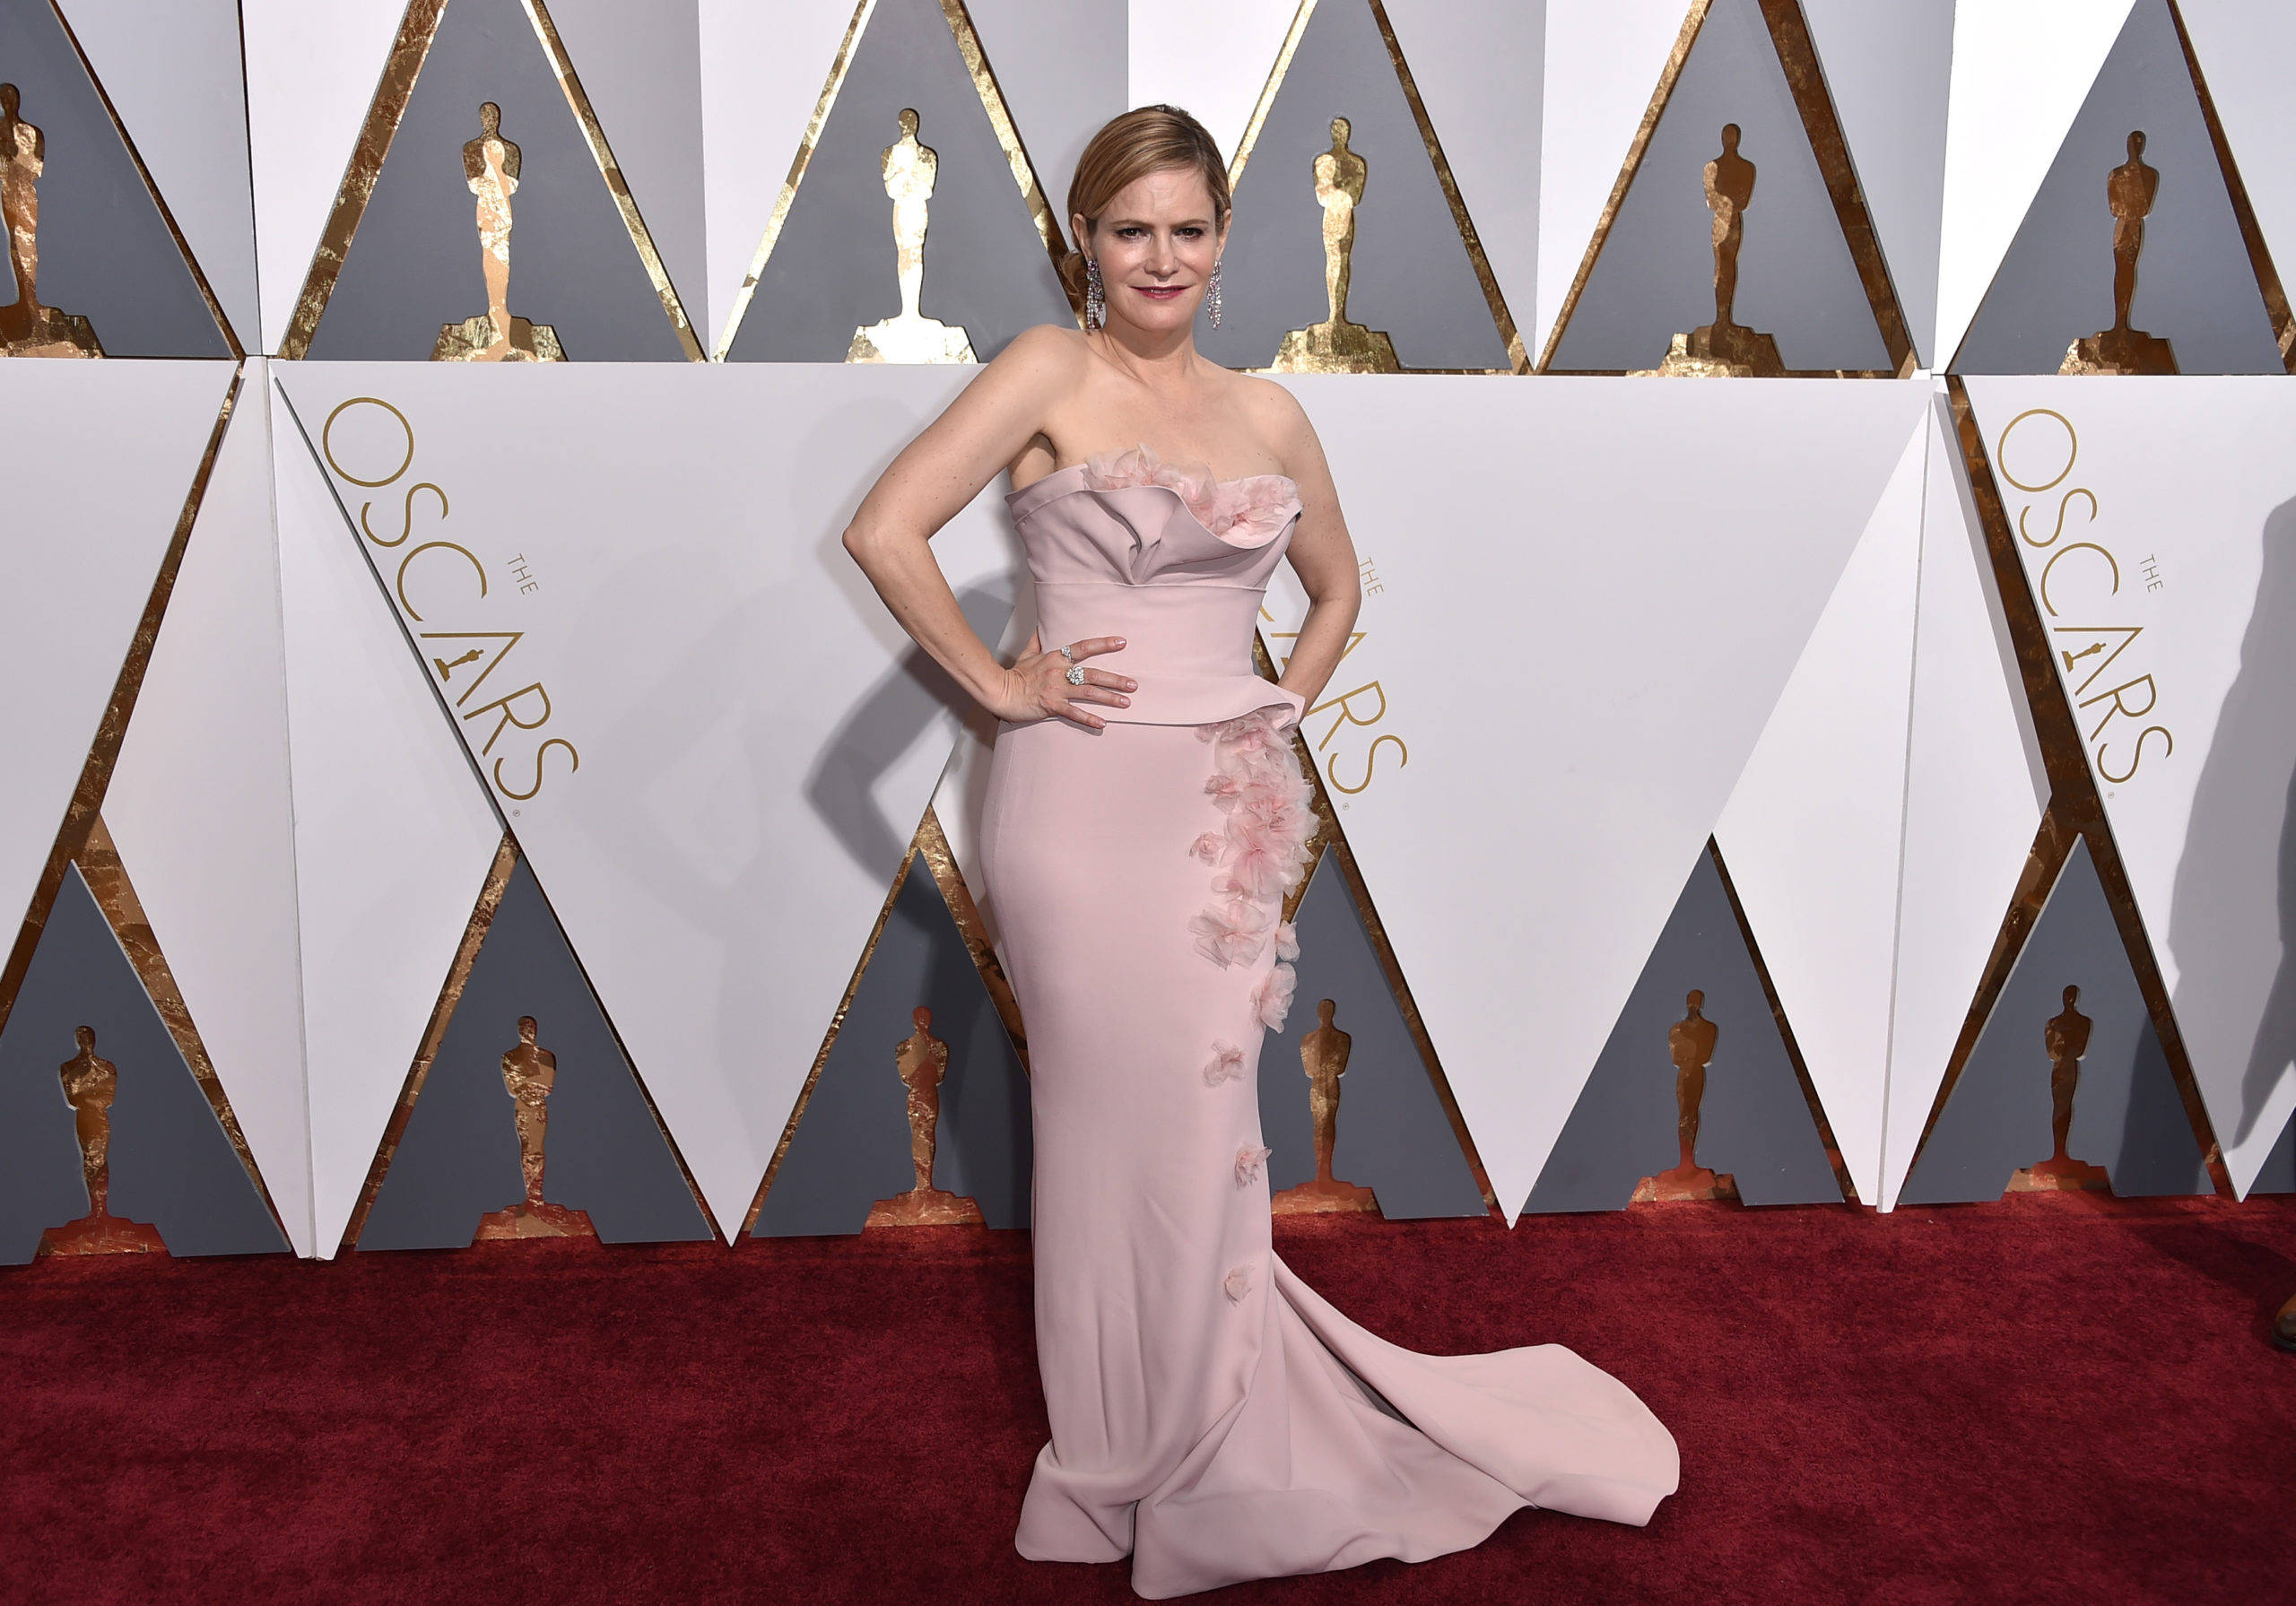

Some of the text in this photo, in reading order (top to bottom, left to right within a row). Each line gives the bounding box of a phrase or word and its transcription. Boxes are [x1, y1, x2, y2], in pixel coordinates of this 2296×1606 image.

[508, 552, 538, 595] THE
[1358, 557, 1385, 596] THE
[2140, 553, 2163, 593] THE
[322, 397, 579, 801] OSCARS
[1997, 409, 2173, 784] OSCARS
